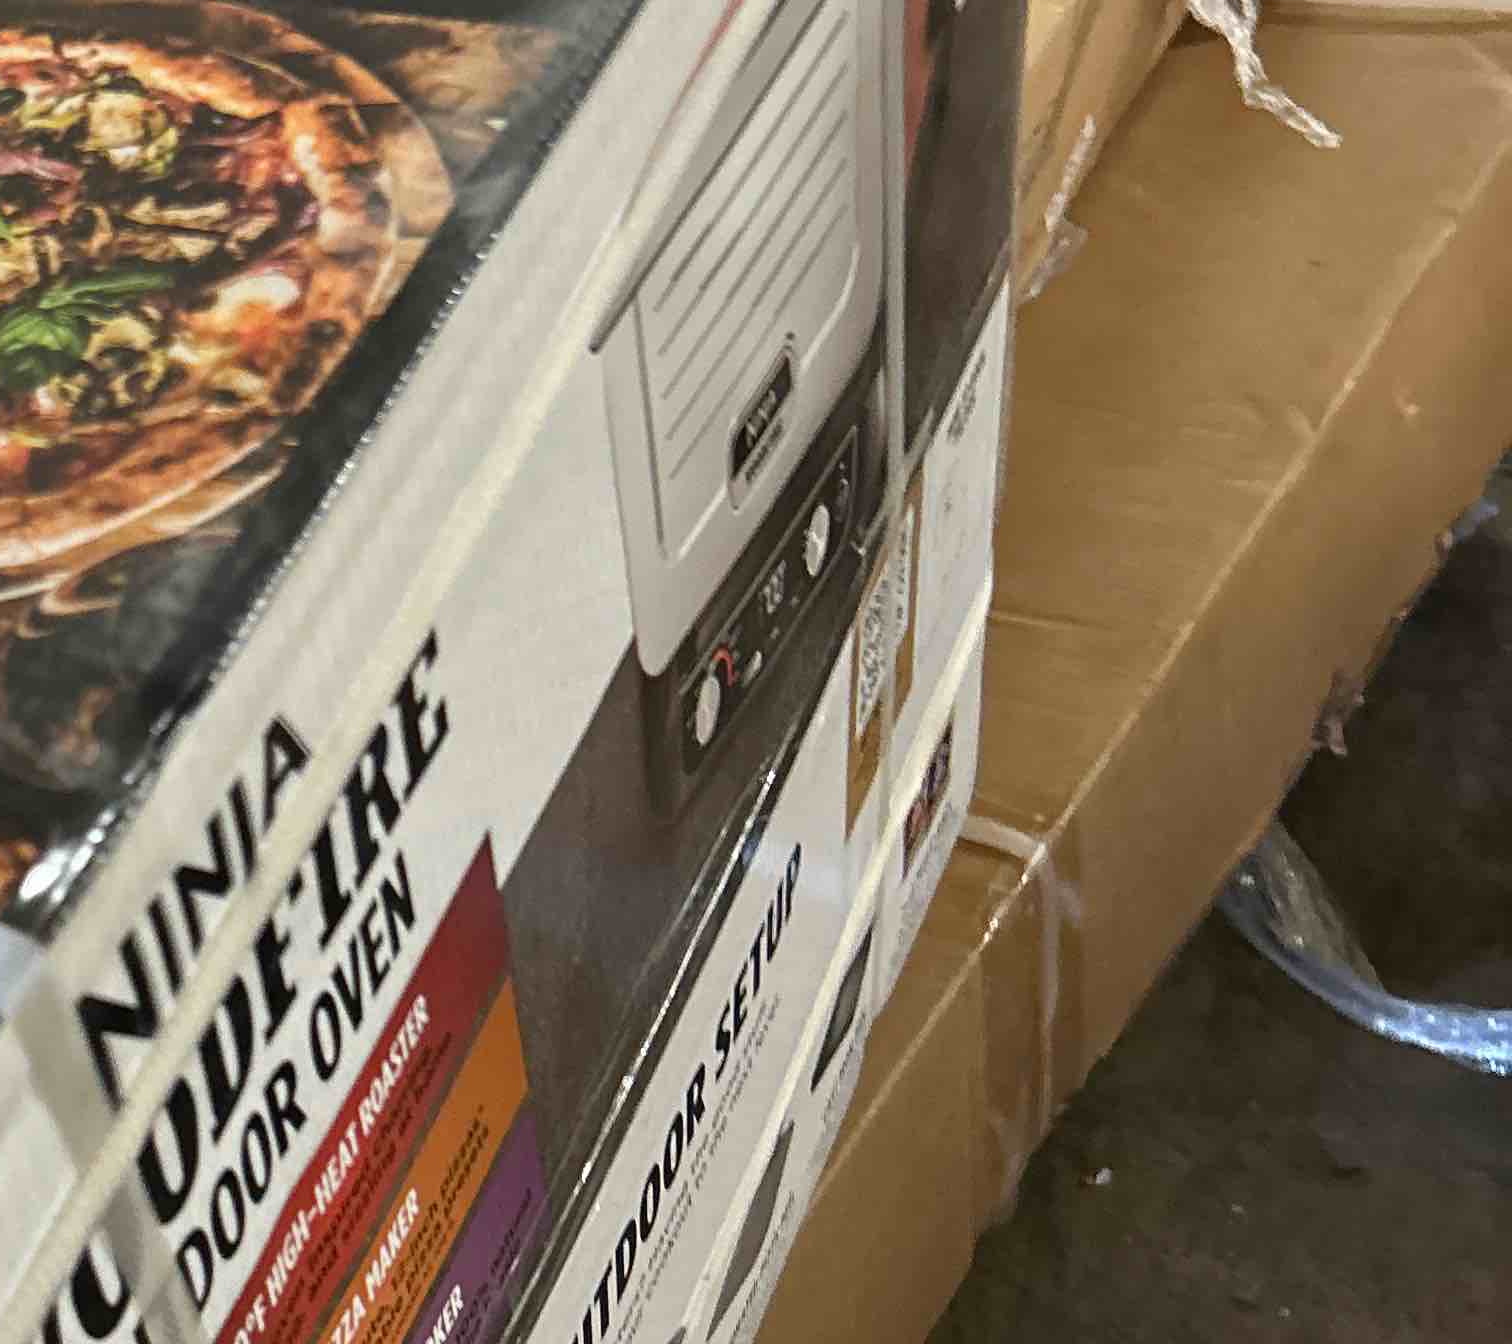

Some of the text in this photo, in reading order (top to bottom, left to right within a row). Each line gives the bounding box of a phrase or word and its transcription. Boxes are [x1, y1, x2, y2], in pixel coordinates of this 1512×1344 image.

[72, 677, 312, 1127] NINJA
[305, 844, 416, 1098] OVEN
[712, 832, 801, 1087] SETUP
[264, 1114, 361, 1312] HIGH-HEAT
[358, 982, 430, 1141] ROASTER
[364, 1180, 419, 1307] MAKER
